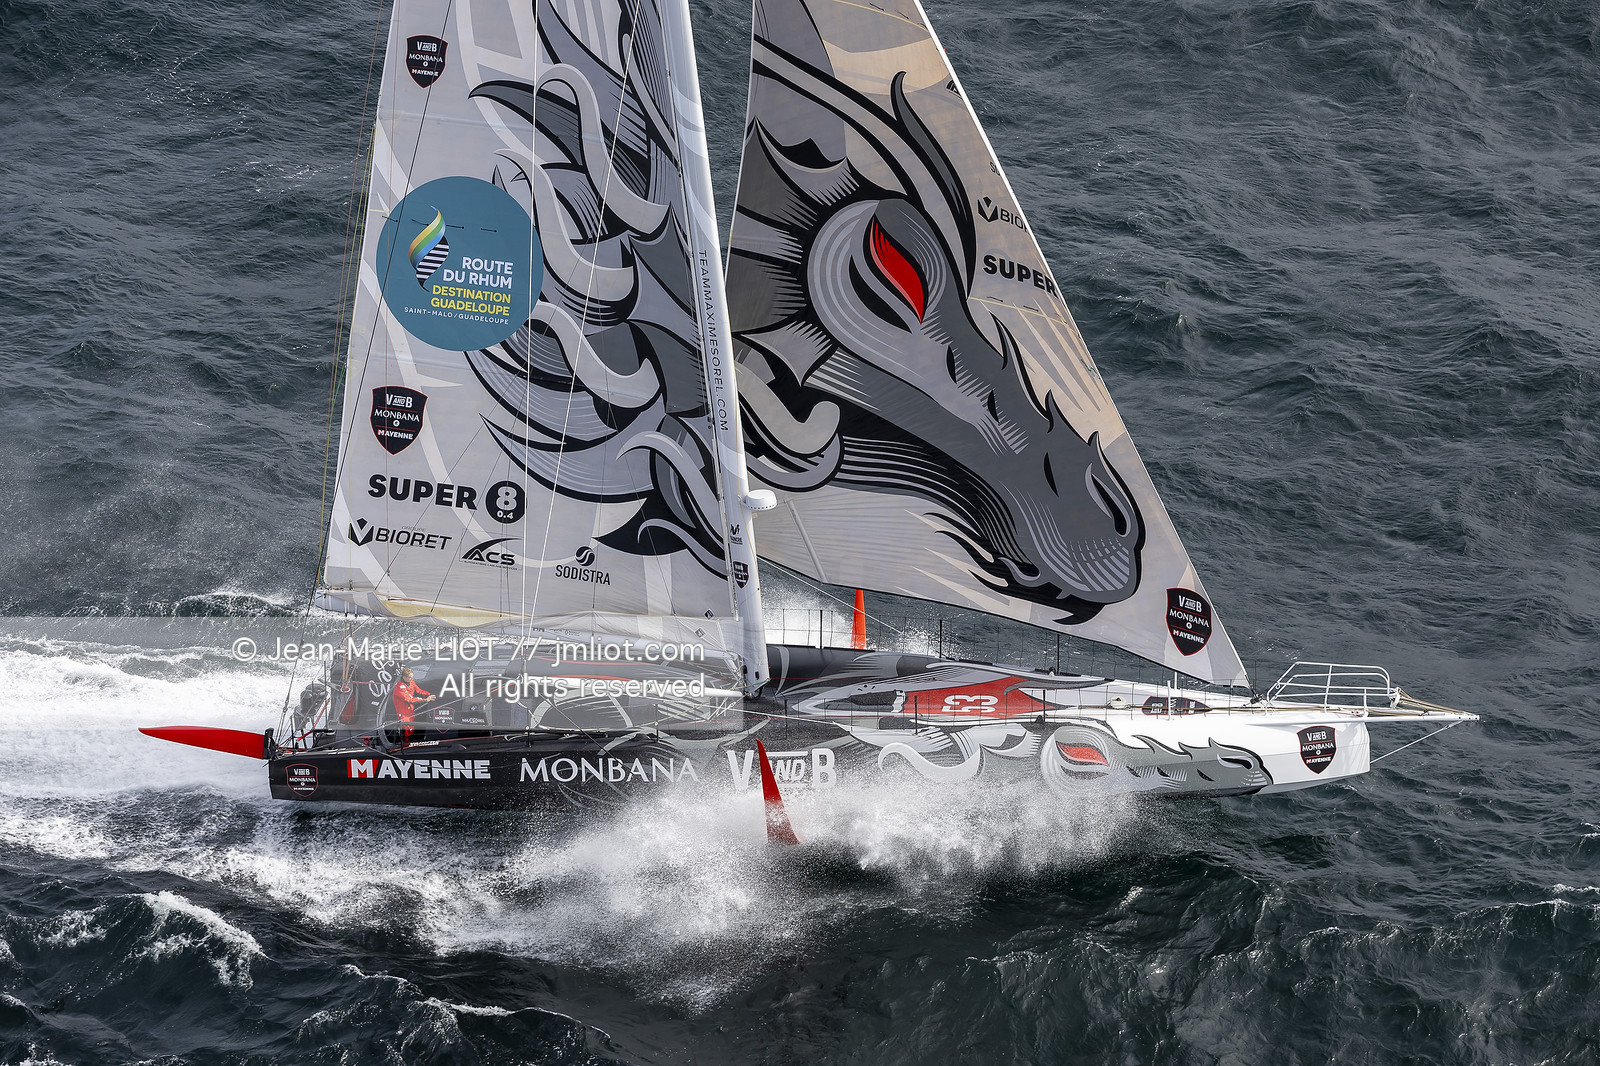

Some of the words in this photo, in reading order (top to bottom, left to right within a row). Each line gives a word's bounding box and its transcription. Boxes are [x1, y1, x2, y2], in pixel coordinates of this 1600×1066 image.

[409, 53, 443, 63] MONBANA
[462, 256, 514, 275] ROUTE
[442, 268, 466, 283] DU
[469, 272, 513, 289] RHUM
[983, 254, 1058, 298] SUPER
[432, 285, 511, 304] DESTINATION
[430, 297, 510, 316] GUADELOUPE
[699, 250, 729, 431] TEAMMAXIMESOREL.COM
[374, 409, 420, 423] MONBANA
[377, 429, 414, 440] MAYENNE
[368, 474, 478, 511] SUPER
[496, 486, 518, 511] 8
[496, 510, 514, 520] 0.4
[375, 527, 452, 550] BIORET
[461, 545, 516, 566] ACS
[555, 564, 611, 586] SODISTRA
[1169, 609, 1210, 628] MONBANA
[1173, 629, 1205, 644] MAYENNE
[1302, 742, 1335, 751] MONBANA
[347, 758, 492, 780] MAYENNE
[519, 757, 699, 784] MONBANA
